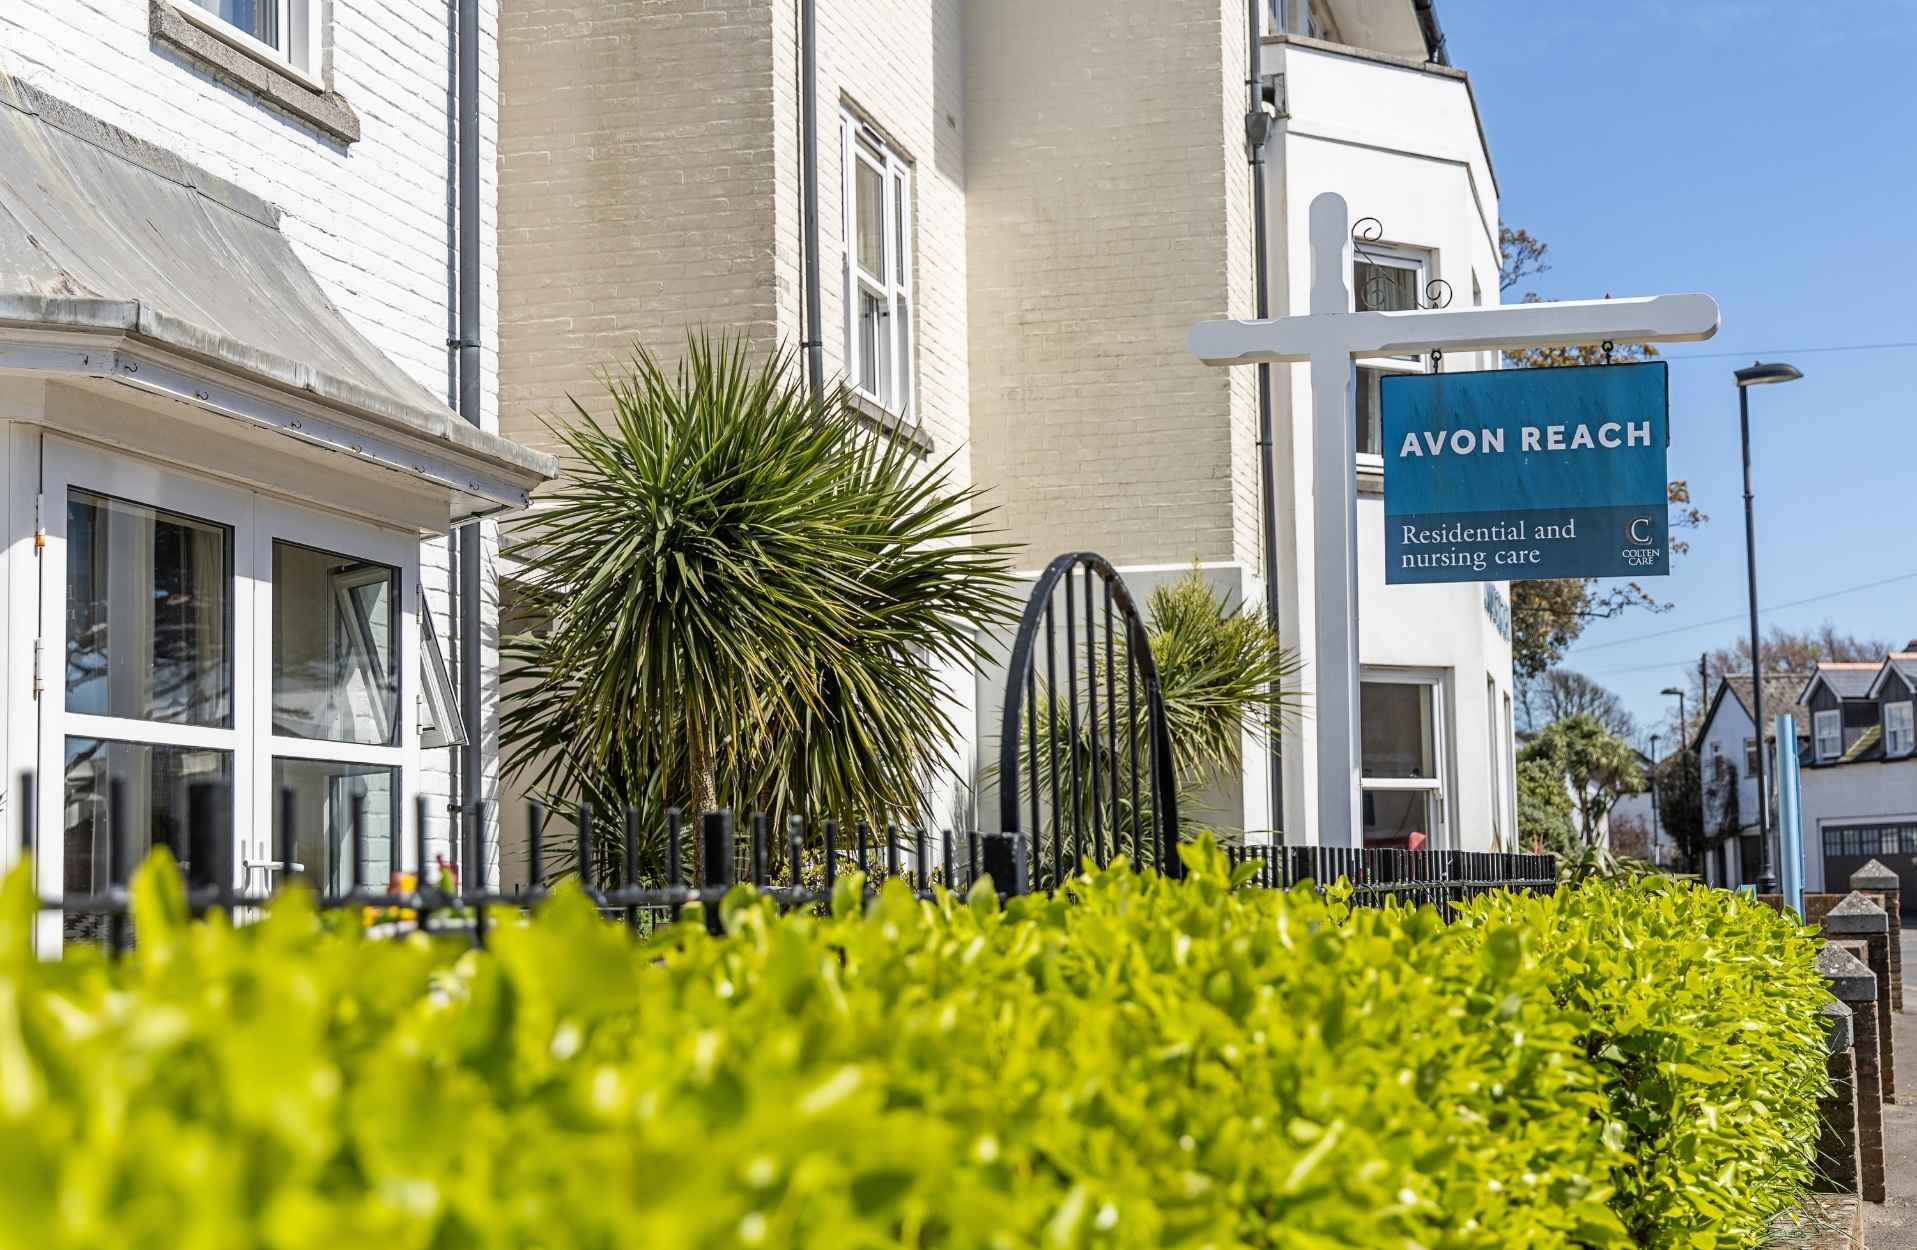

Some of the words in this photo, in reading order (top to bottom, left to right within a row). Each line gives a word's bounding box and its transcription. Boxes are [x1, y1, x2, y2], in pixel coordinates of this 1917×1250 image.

[1400, 428, 1505, 457] AVON
[1521, 421, 1651, 451] REACH
[1401, 520, 1525, 545] Residential
[1534, 518, 1576, 541] and
[1627, 517, 1652, 545] C
[1401, 547, 1487, 571] nursing
[1495, 548, 1541, 564] care
[1622, 548, 1660, 558] COLTEN
[1628, 557, 1654, 566] CARE
